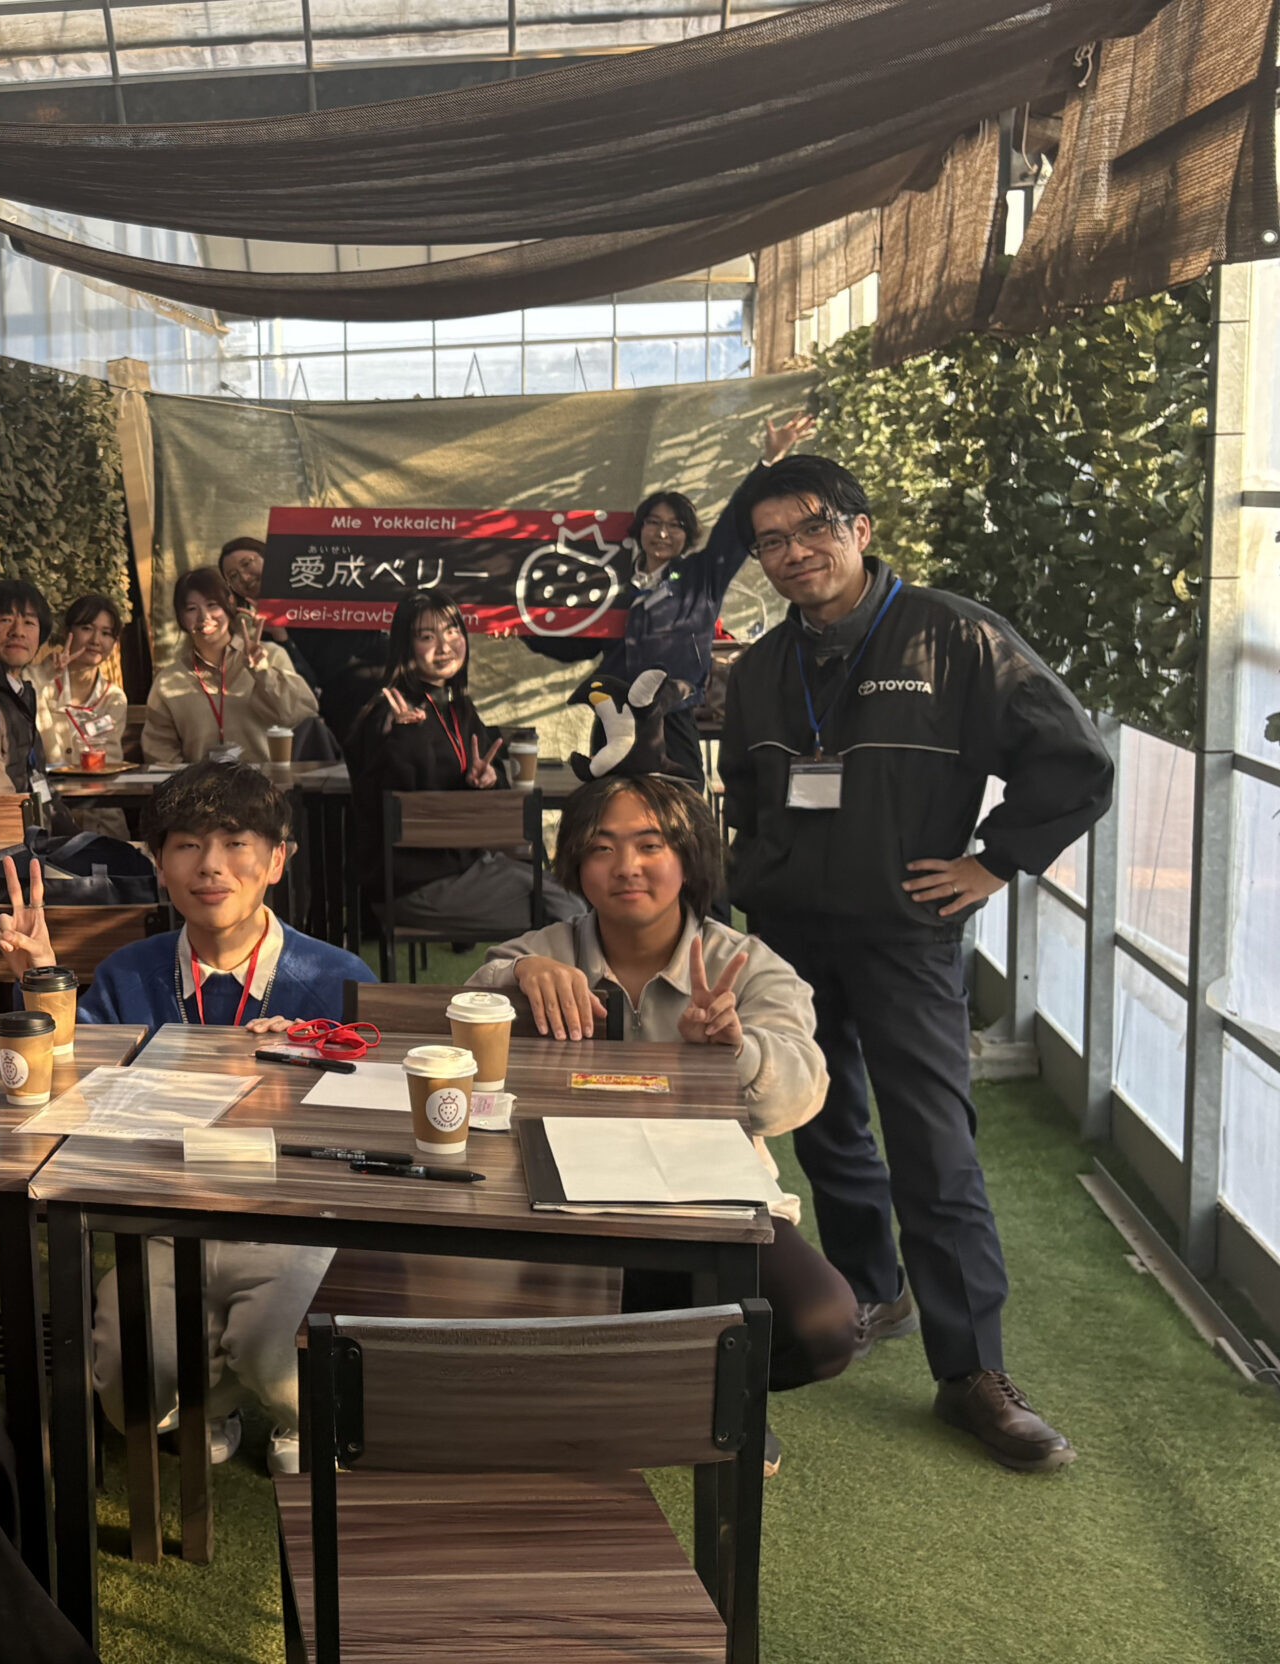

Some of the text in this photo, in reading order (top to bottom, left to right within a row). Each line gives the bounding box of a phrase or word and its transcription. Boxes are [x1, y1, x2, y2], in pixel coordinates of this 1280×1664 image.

[330, 515, 456, 530] Mie Yokkaichi
[289, 554, 489, 590] 愛成ベリー
[877, 680, 933, 695] TOYOTA
